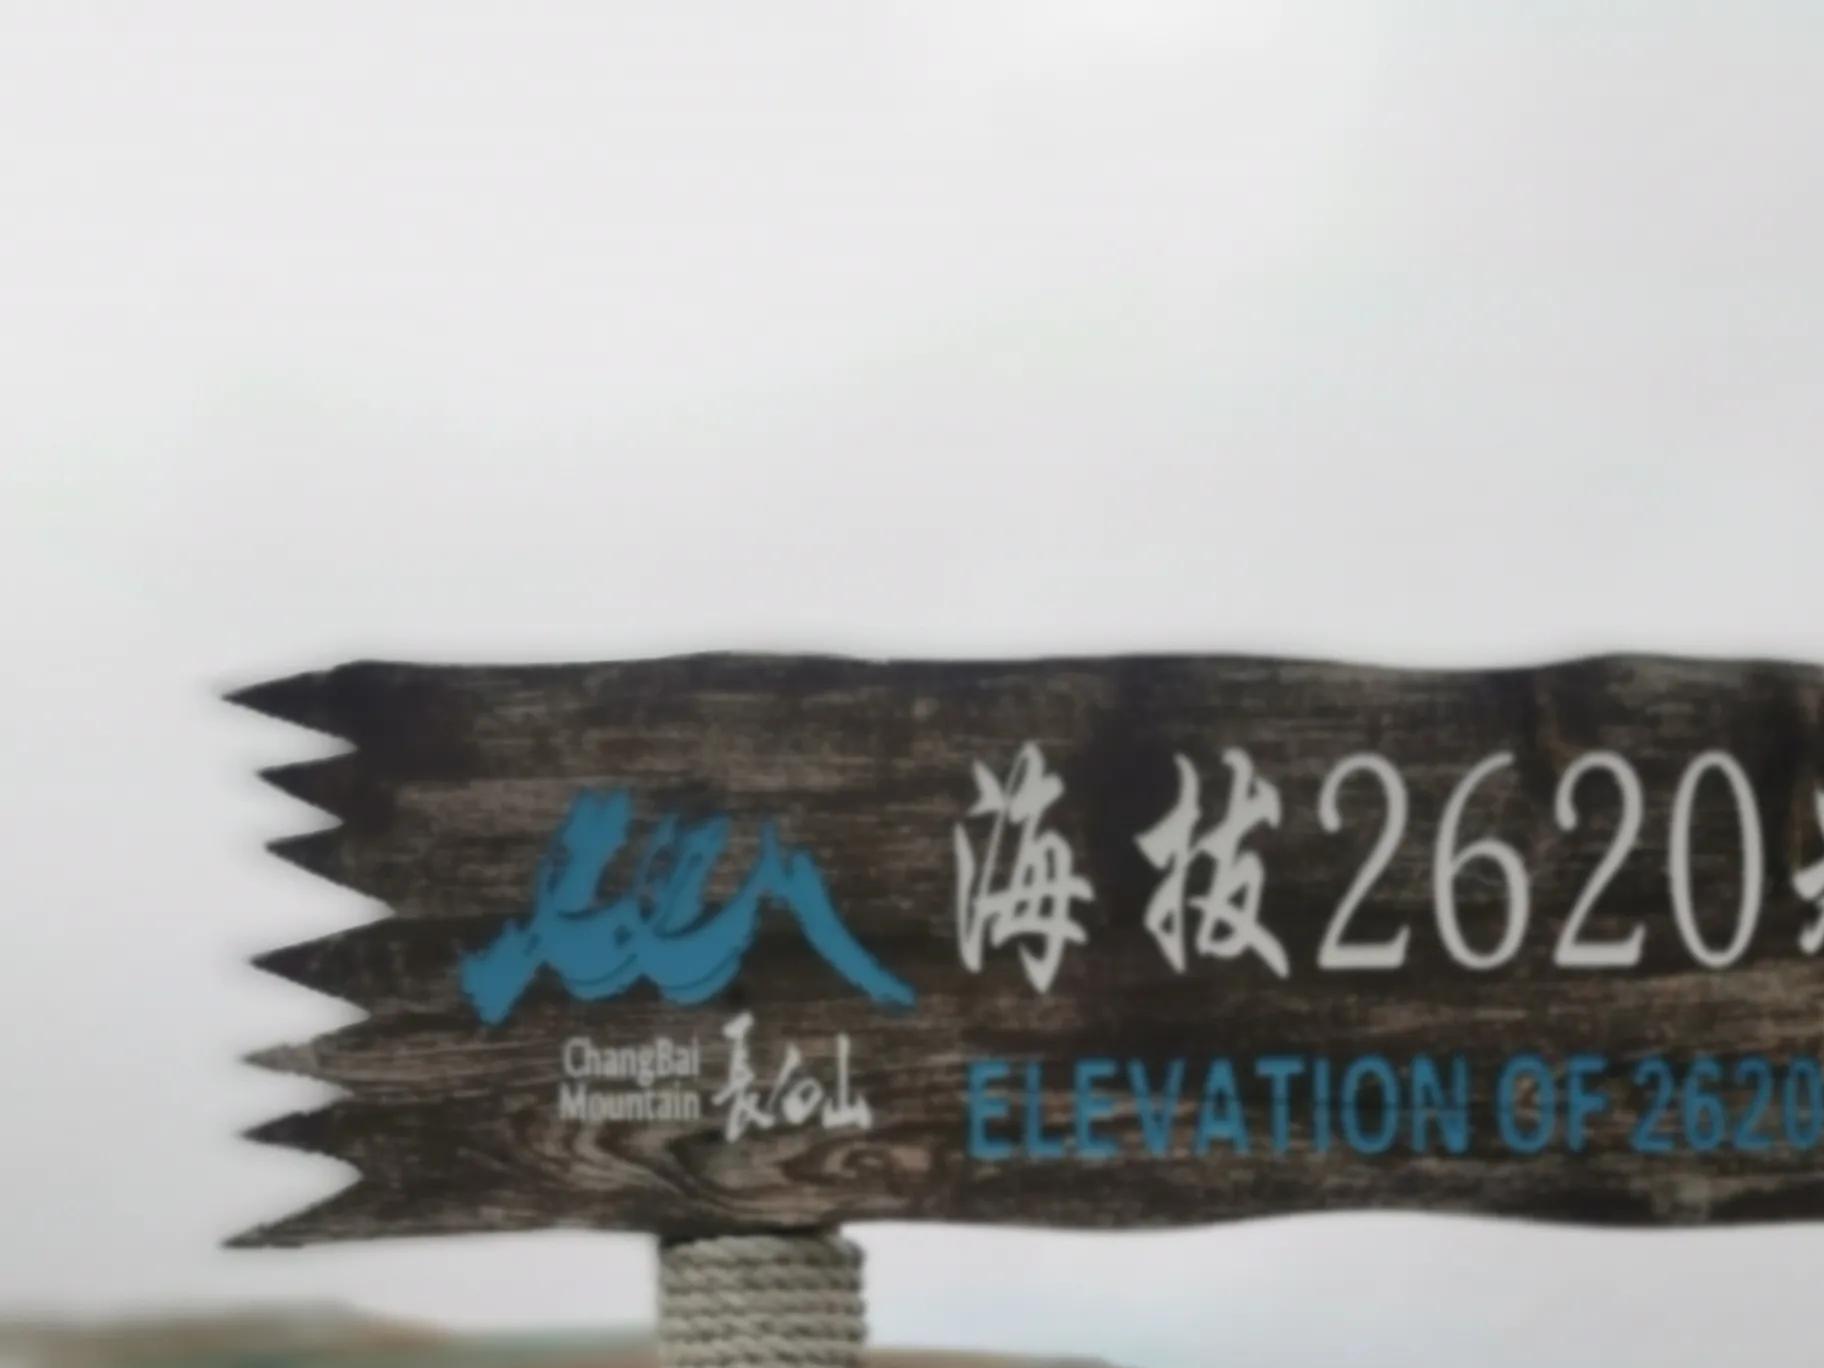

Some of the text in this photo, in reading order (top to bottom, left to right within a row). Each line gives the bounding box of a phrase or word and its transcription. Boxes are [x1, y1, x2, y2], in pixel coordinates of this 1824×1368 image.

[563, 1037, 700, 1086] ChangBai
[559, 1083, 700, 1122] Mountain
[965, 1053, 1472, 1162] ELEVATION
[1494, 1051, 1610, 1156] OF
